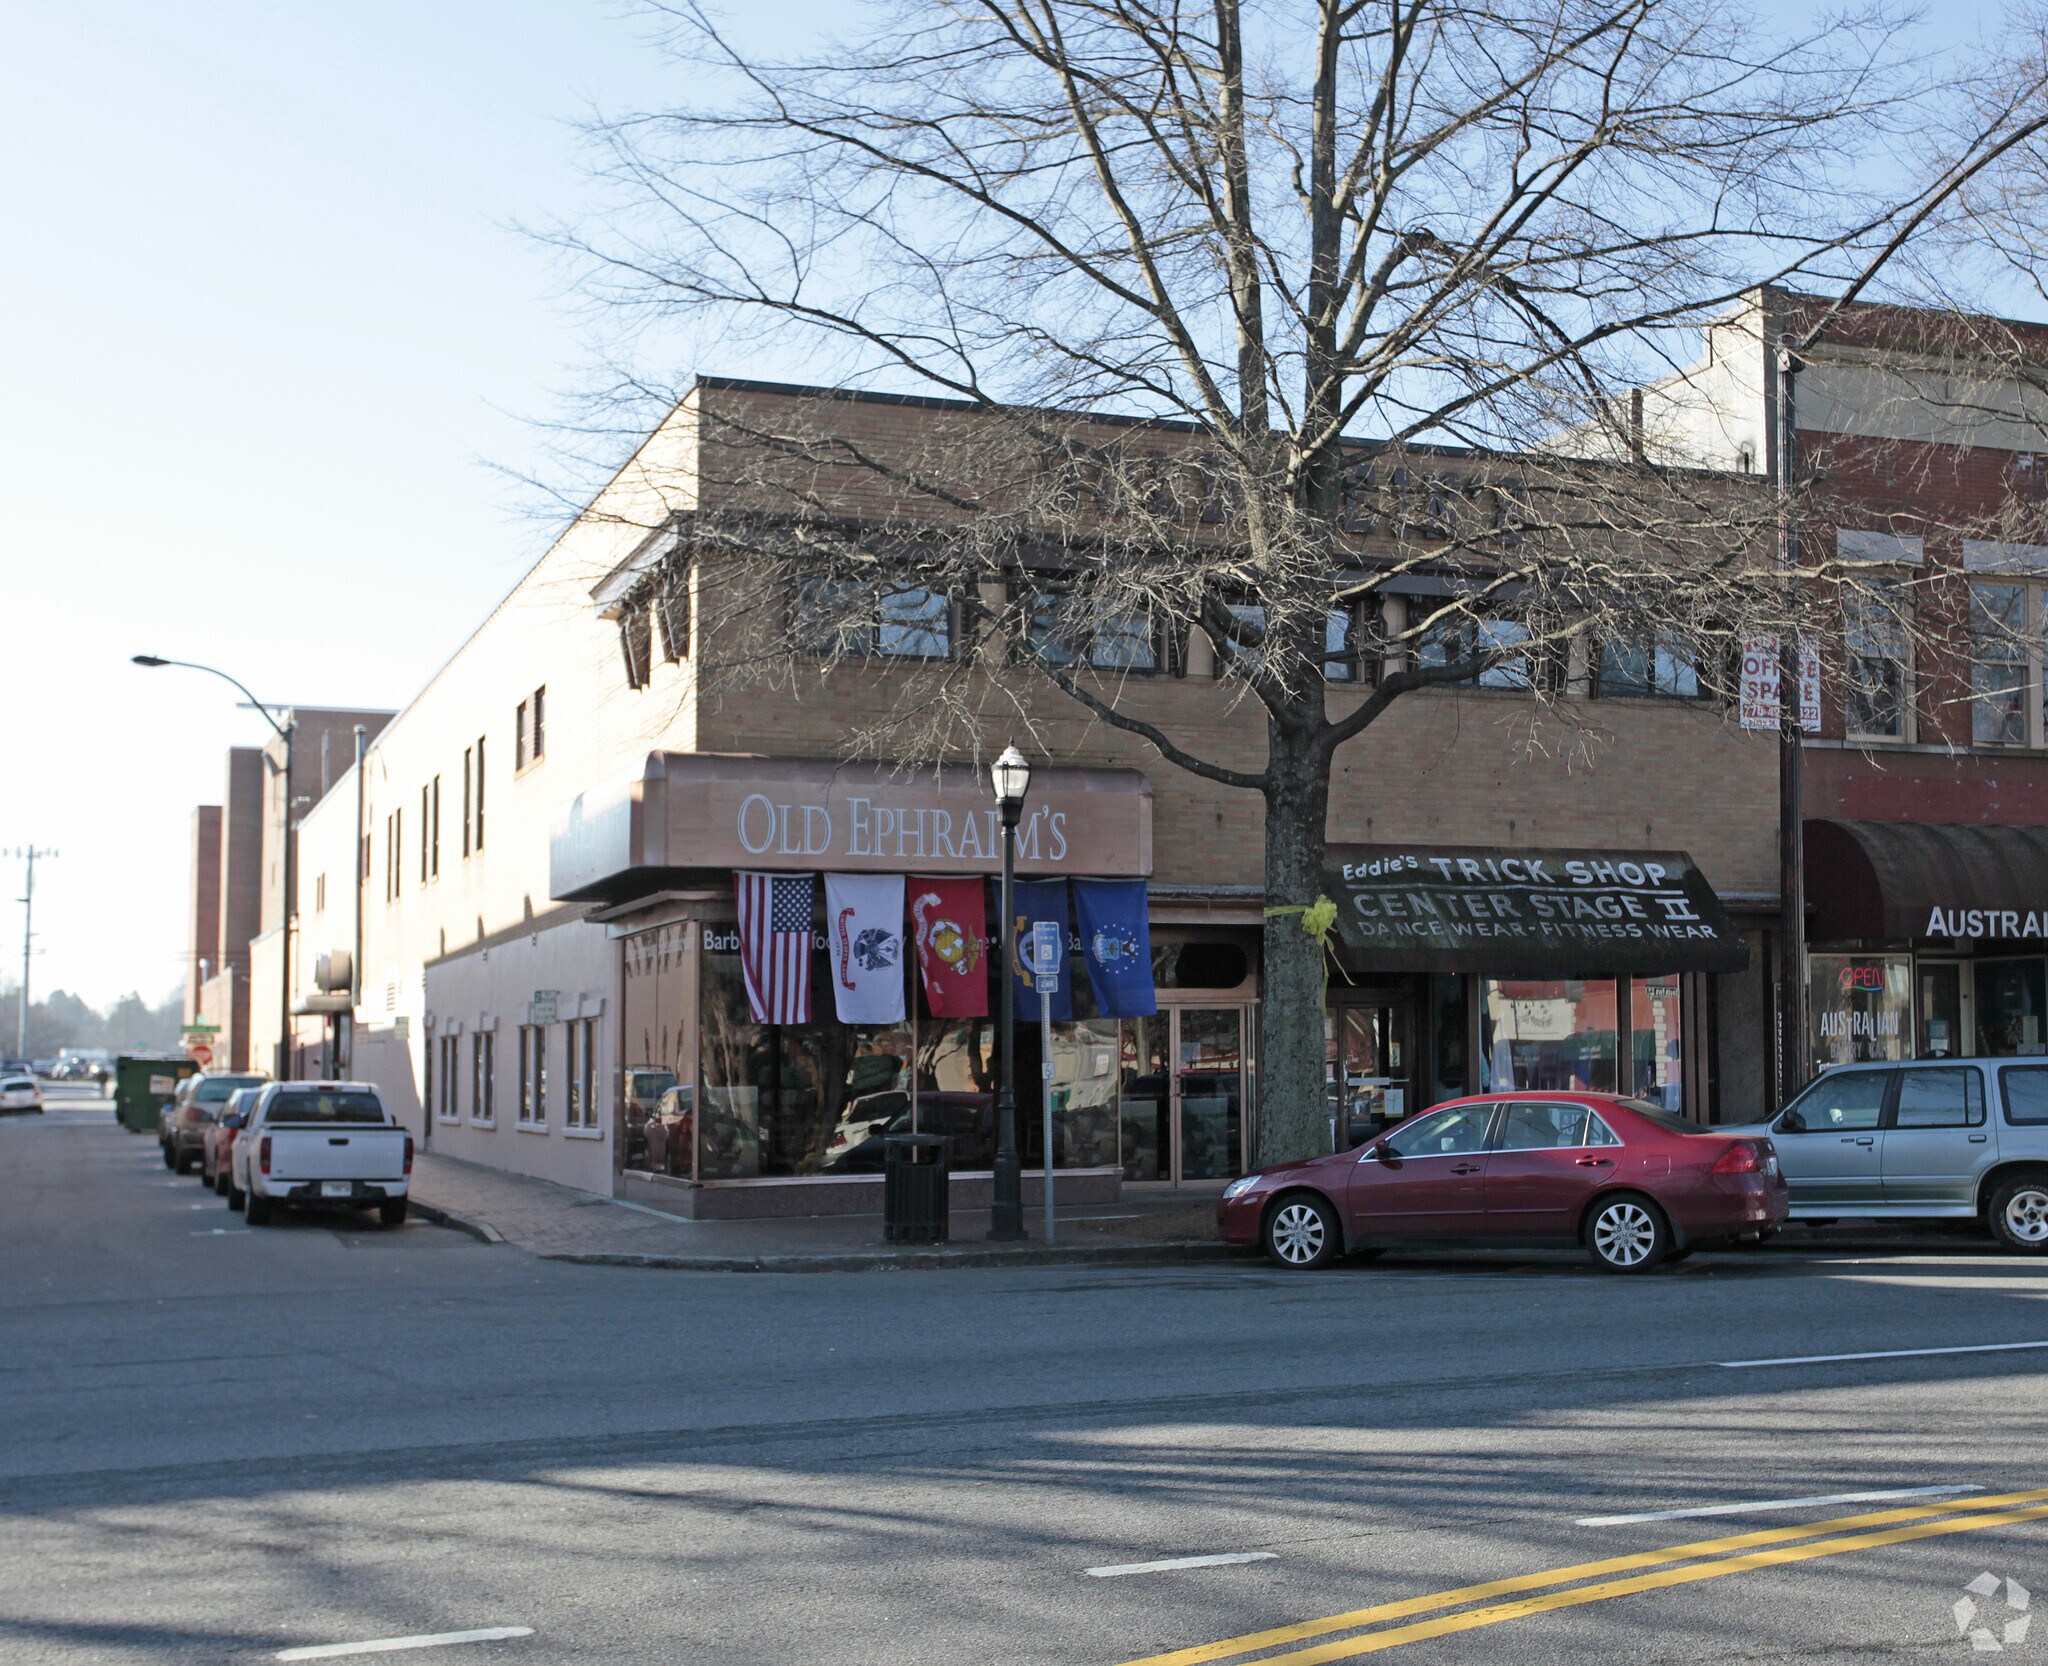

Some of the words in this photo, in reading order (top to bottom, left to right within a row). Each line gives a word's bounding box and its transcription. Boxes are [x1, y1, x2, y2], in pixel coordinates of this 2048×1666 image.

[1744, 657, 1816, 679] OFFCE
[1746, 681, 1813, 702] SPAE
[737, 793, 832, 855] OLD
[1342, 855, 1419, 880] Eddie's
[1429, 858, 1556, 883] TRICK
[1565, 861, 1666, 886] SHOP
[1353, 891, 1522, 918] CENTER
[1529, 893, 1648, 920] STAGE
[1655, 898, 1700, 920] II
[1358, 921, 1445, 936] DANCE
[1646, 923, 1718, 939] WEAR
[1841, 967, 1885, 987] OPEN
[1820, 1011, 1899, 1041] AUSTRALIAN
